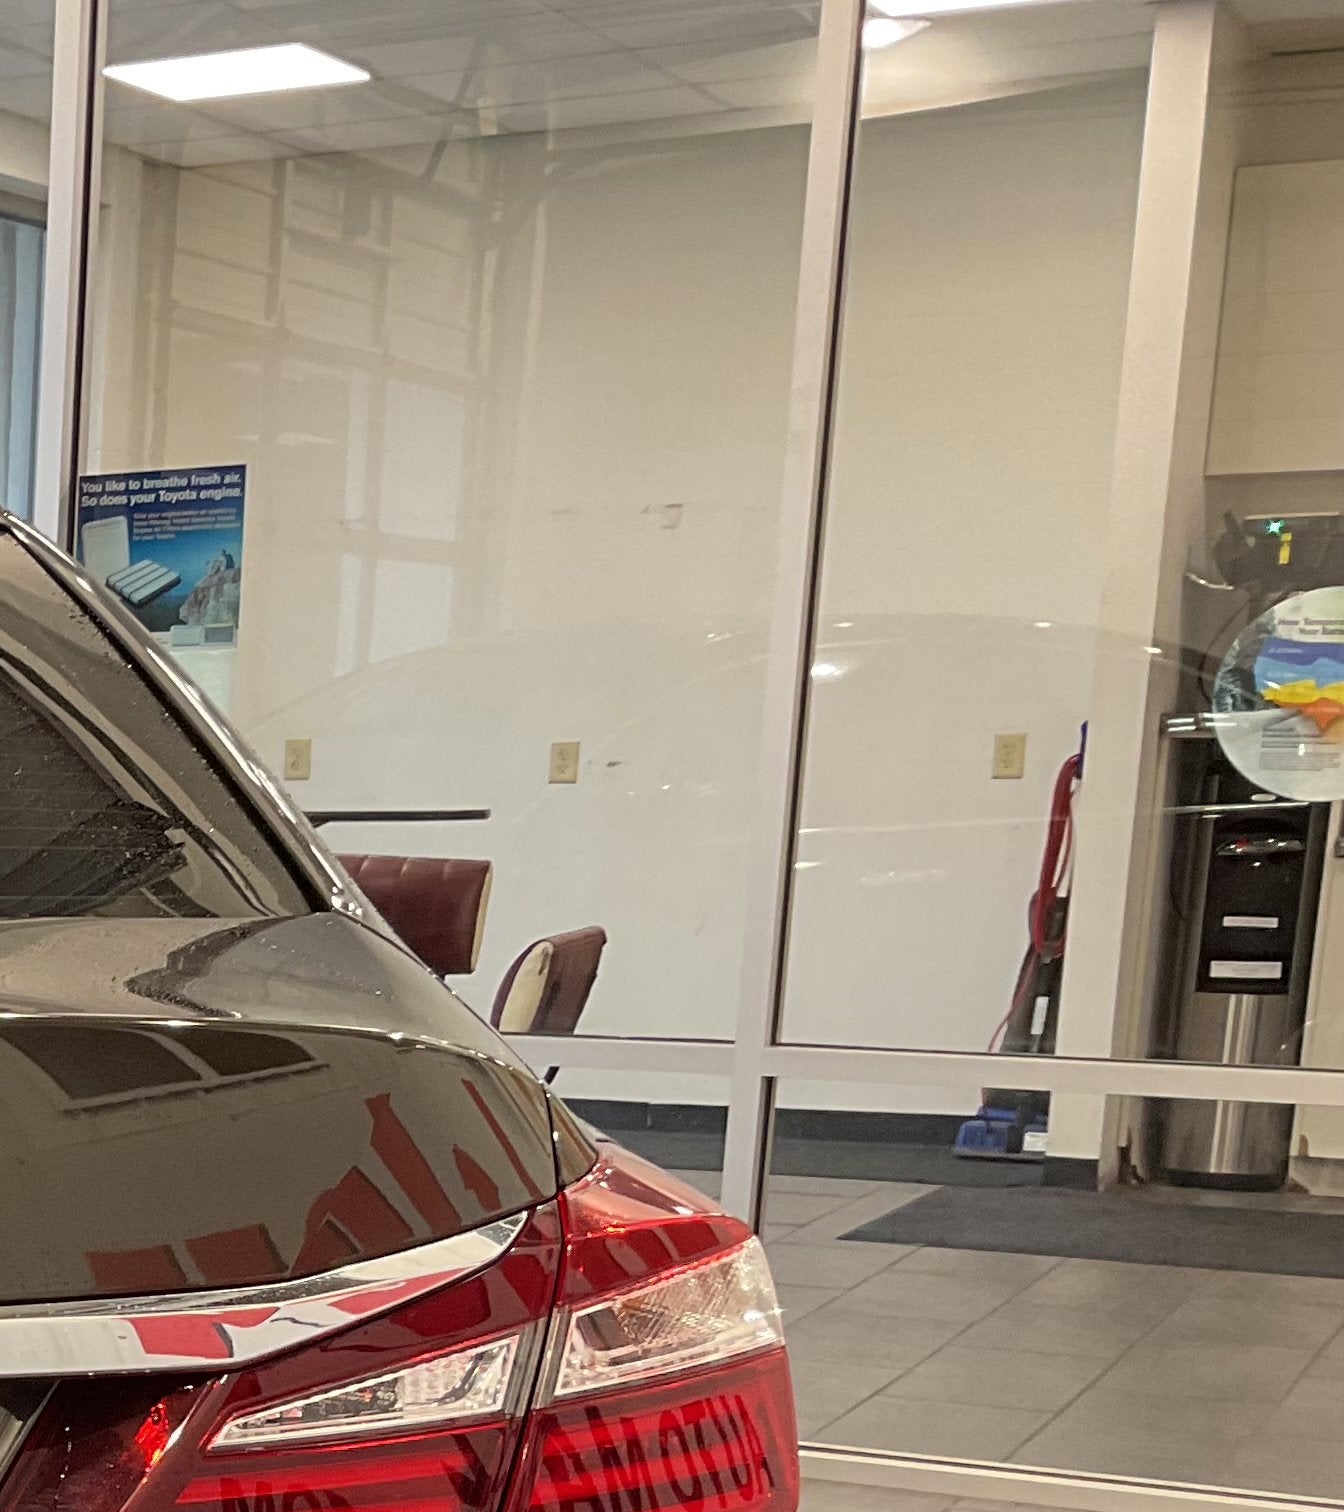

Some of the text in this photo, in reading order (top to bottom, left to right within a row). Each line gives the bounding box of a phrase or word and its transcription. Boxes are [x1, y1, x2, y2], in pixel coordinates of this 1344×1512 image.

[81, 481, 103, 493] You
[105, 479, 126, 491] like
[128, 479, 141, 490] to
[143, 476, 188, 489] breathe
[191, 473, 221, 487] fresh
[81, 495, 97, 507] So
[99, 493, 127, 506] does
[129, 492, 156, 506] your
[159, 490, 197, 503] Toyota
